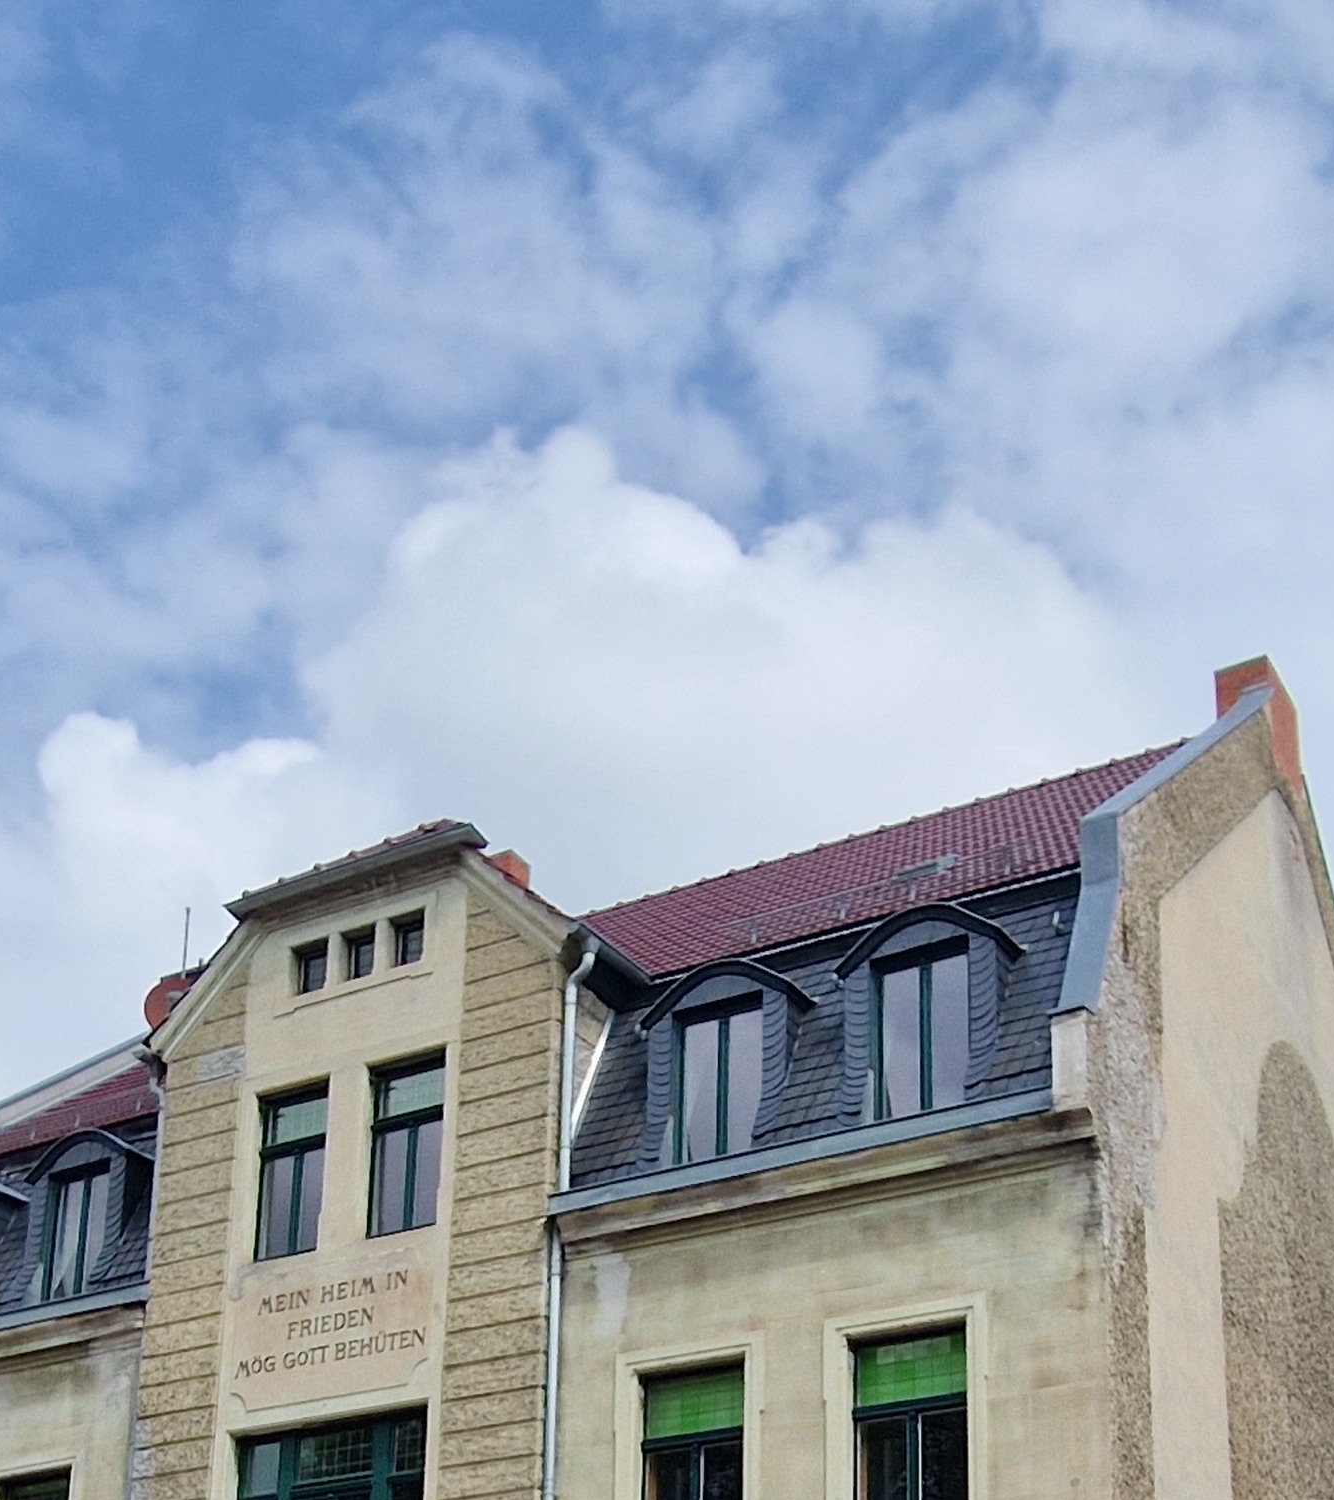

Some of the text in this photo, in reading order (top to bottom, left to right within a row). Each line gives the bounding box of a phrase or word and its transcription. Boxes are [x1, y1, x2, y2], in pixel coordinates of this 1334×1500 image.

[257, 1268, 409, 1316] MEIN HEIM IN
[286, 1306, 375, 1340] FRIEDEN
[234, 1327, 427, 1380] MÖG GOTT BEHÜTEN
